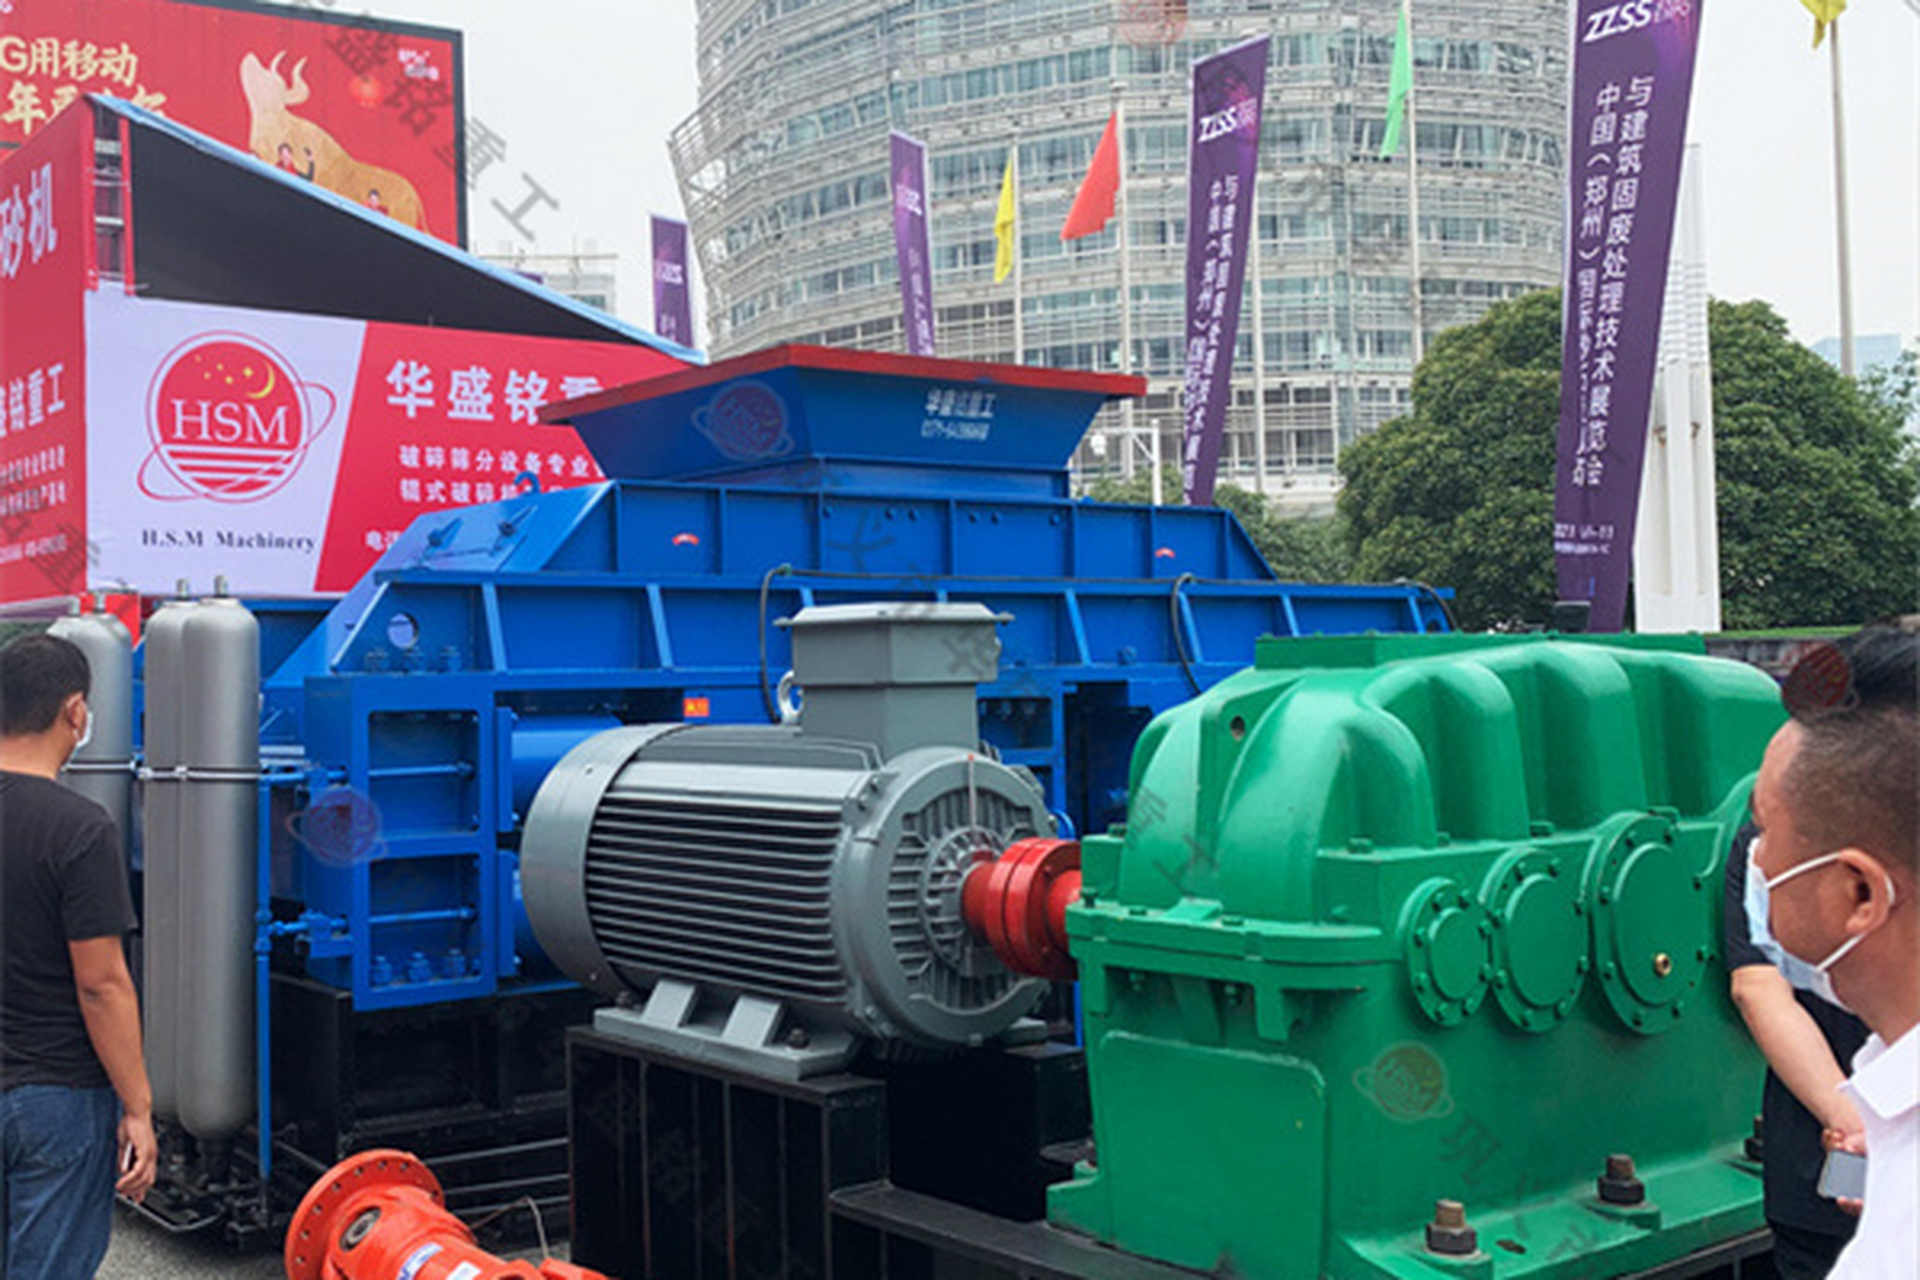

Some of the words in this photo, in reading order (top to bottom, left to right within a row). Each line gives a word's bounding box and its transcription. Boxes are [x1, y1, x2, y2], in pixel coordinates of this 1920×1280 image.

[171, 399, 289, 445] HSM
[399, 445, 605, 478] 破碎筛分设备专业
[142, 528, 204, 548] H.S.M
[215, 530, 316, 554] Machinery
